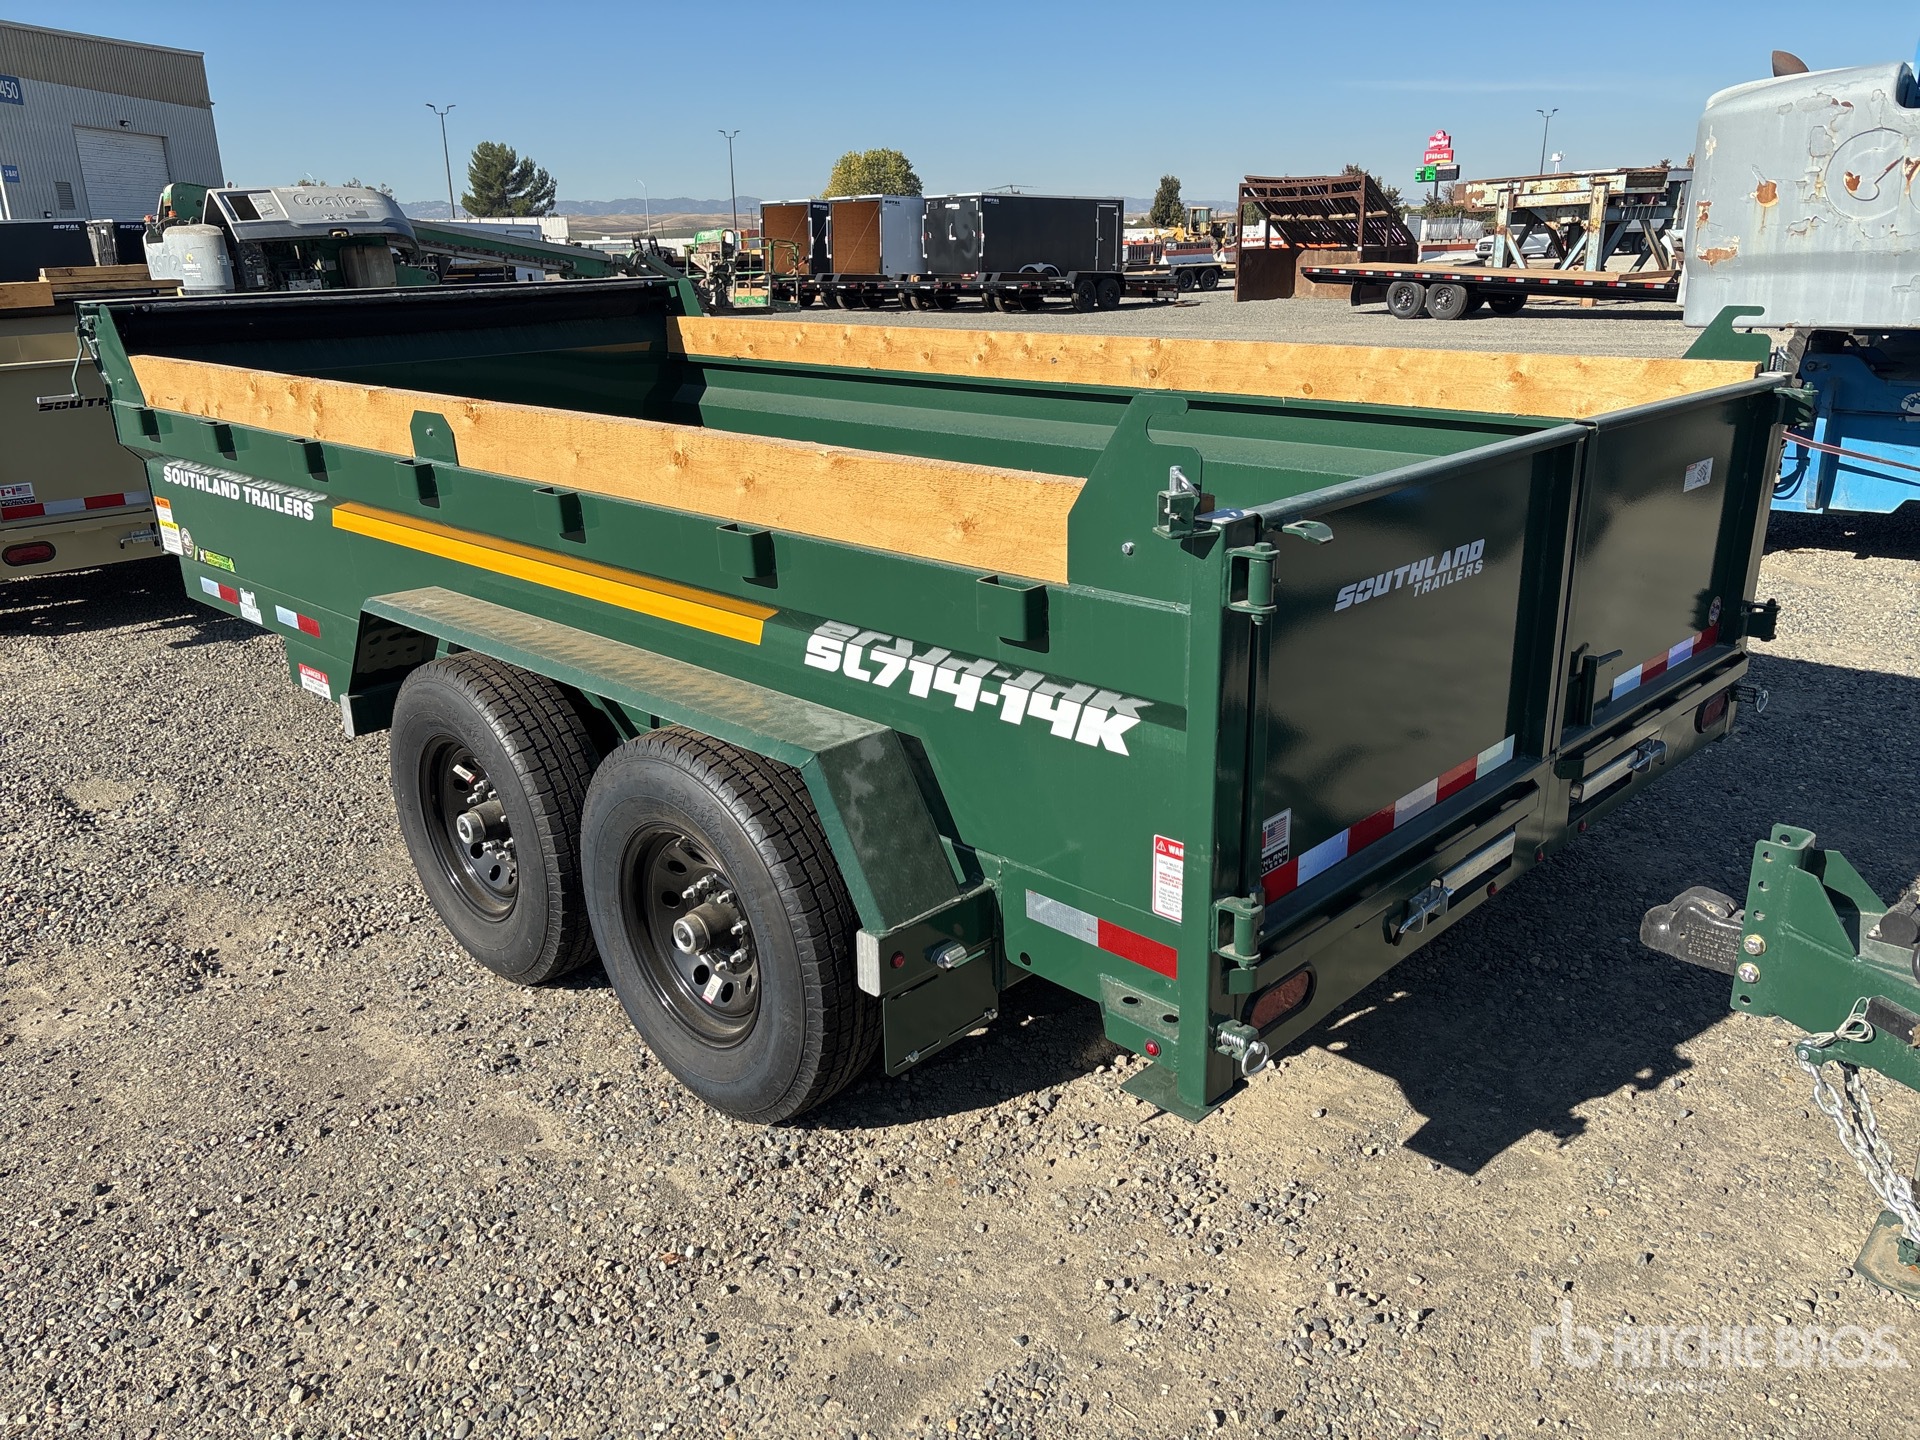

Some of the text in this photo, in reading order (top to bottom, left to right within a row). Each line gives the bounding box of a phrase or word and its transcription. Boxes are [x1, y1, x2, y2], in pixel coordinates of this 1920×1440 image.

[163, 466, 315, 521] SOUTHLAND TRAILERS
[1334, 538, 1485, 612] SOUTHLAND
[1413, 559, 1484, 598] TRAILERS
[804, 634, 1141, 757] SL714-14K
